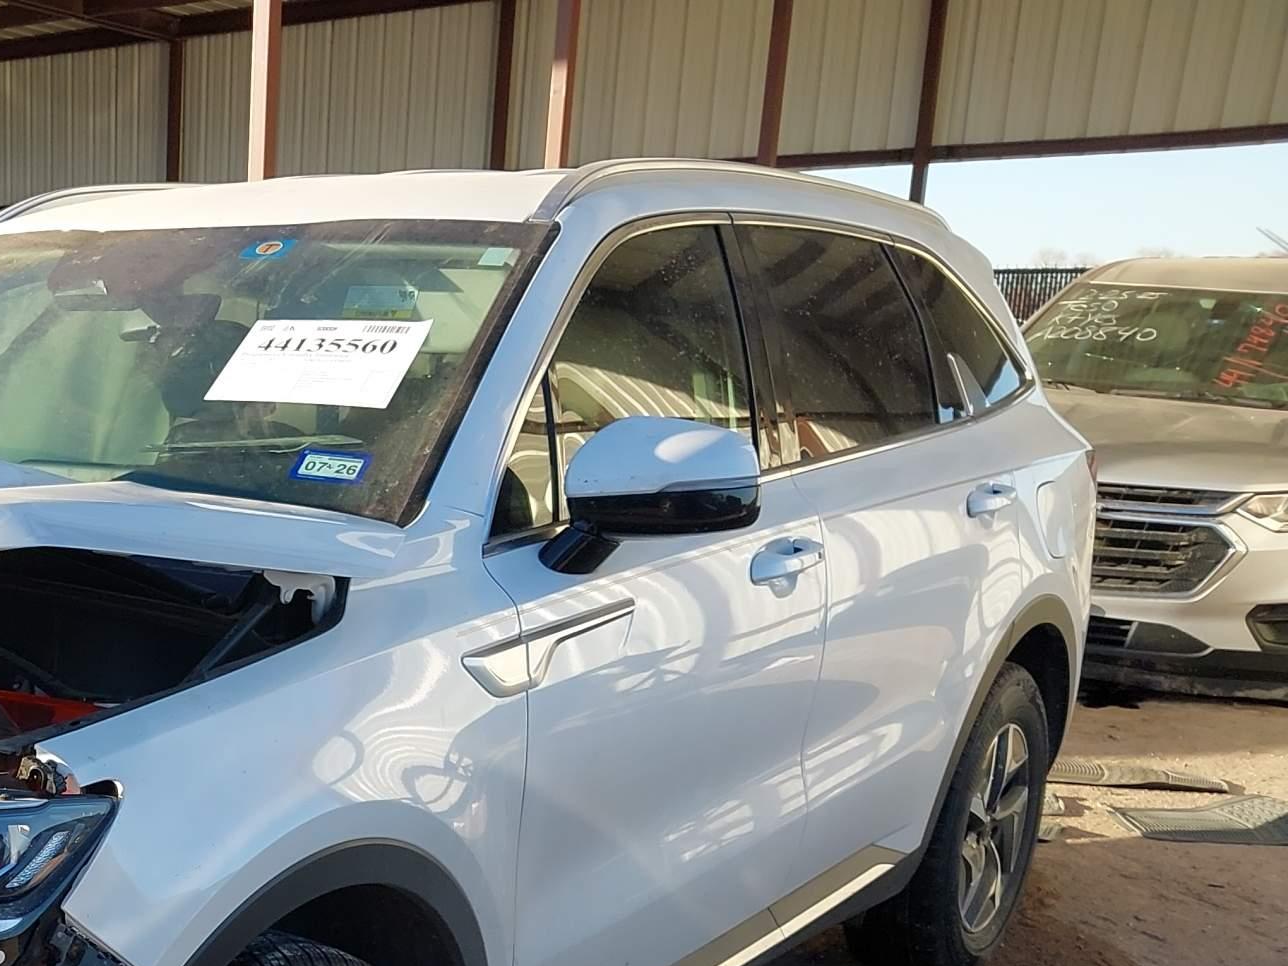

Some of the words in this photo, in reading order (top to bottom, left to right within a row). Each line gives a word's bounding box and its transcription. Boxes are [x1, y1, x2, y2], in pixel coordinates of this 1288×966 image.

[257, 336, 399, 355] 44135560
[304, 460, 328, 473] 07
[334, 463, 358, 476] 26
